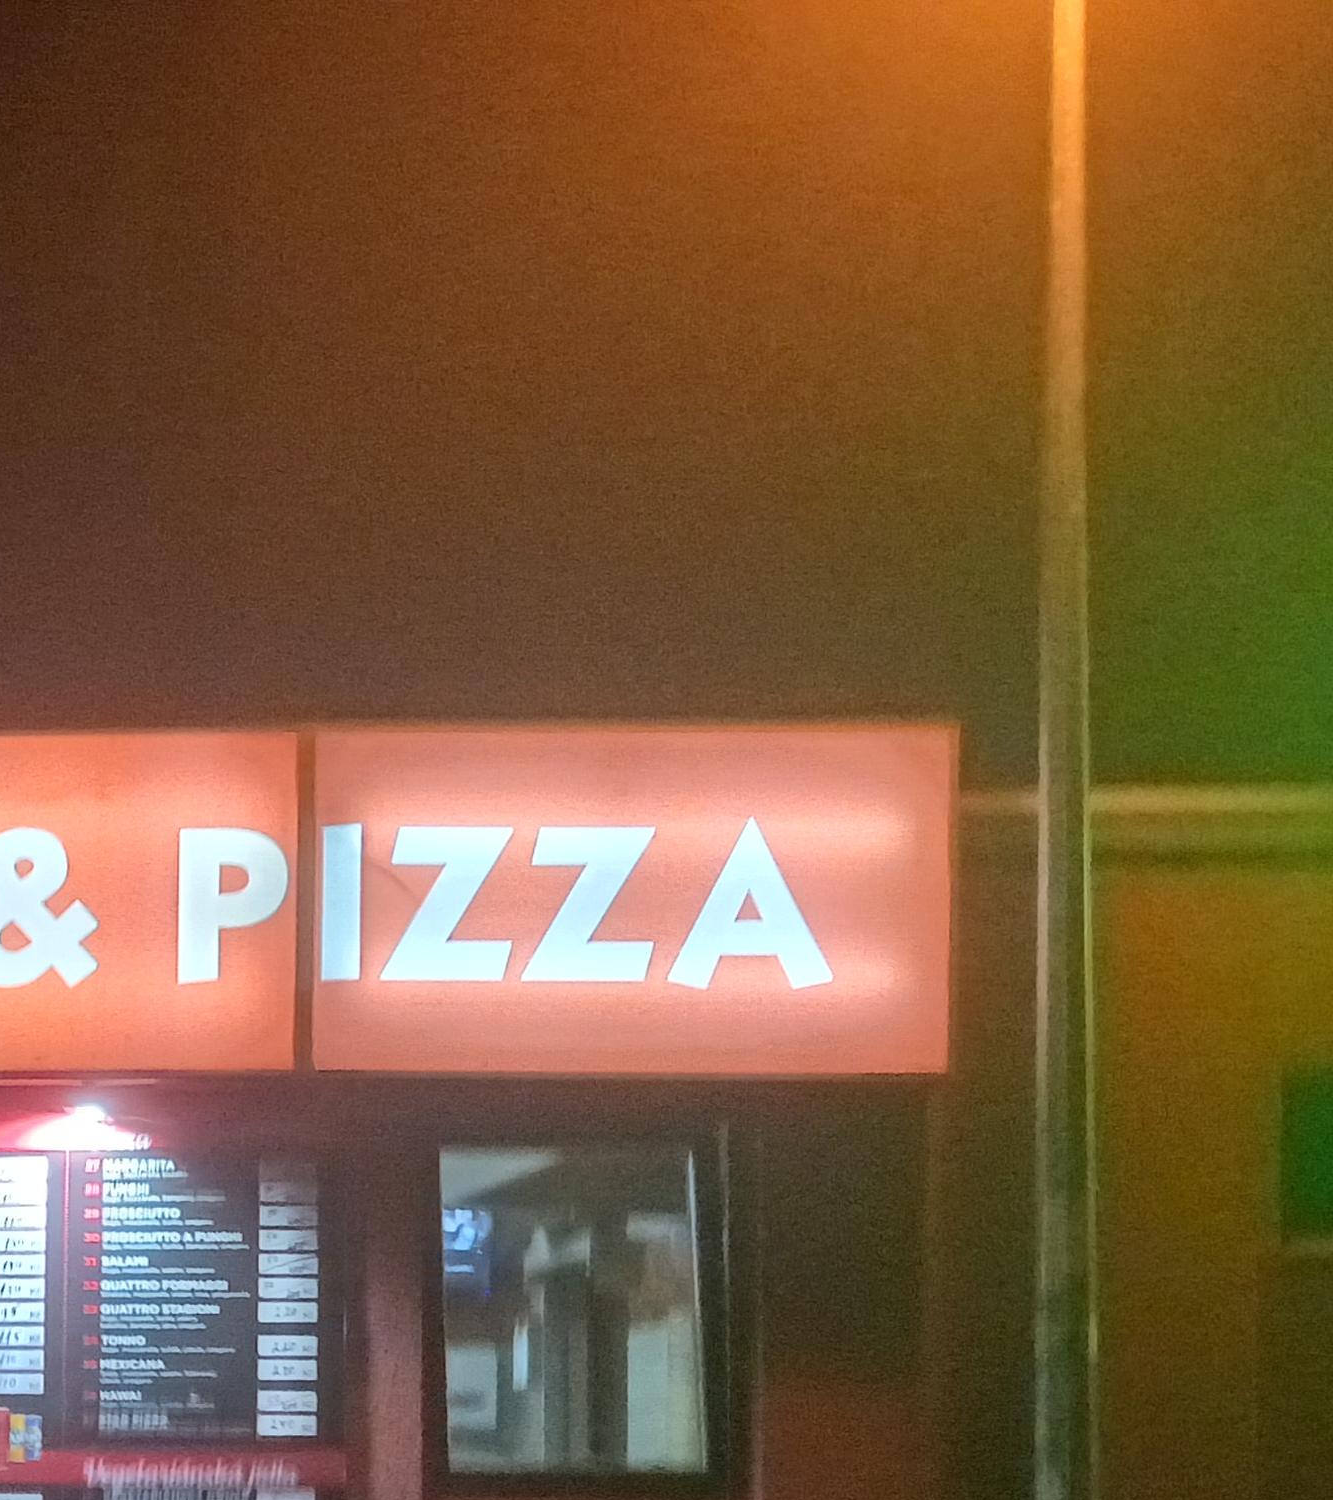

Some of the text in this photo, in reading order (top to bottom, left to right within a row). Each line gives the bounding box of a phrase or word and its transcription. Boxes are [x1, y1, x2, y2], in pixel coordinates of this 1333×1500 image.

[177, 817, 834, 991] PIZZA
[100, 1279, 161, 1291] QUATTRO
[100, 1303, 161, 1315] QUATTRO
[101, 1334, 147, 1346] TONNO
